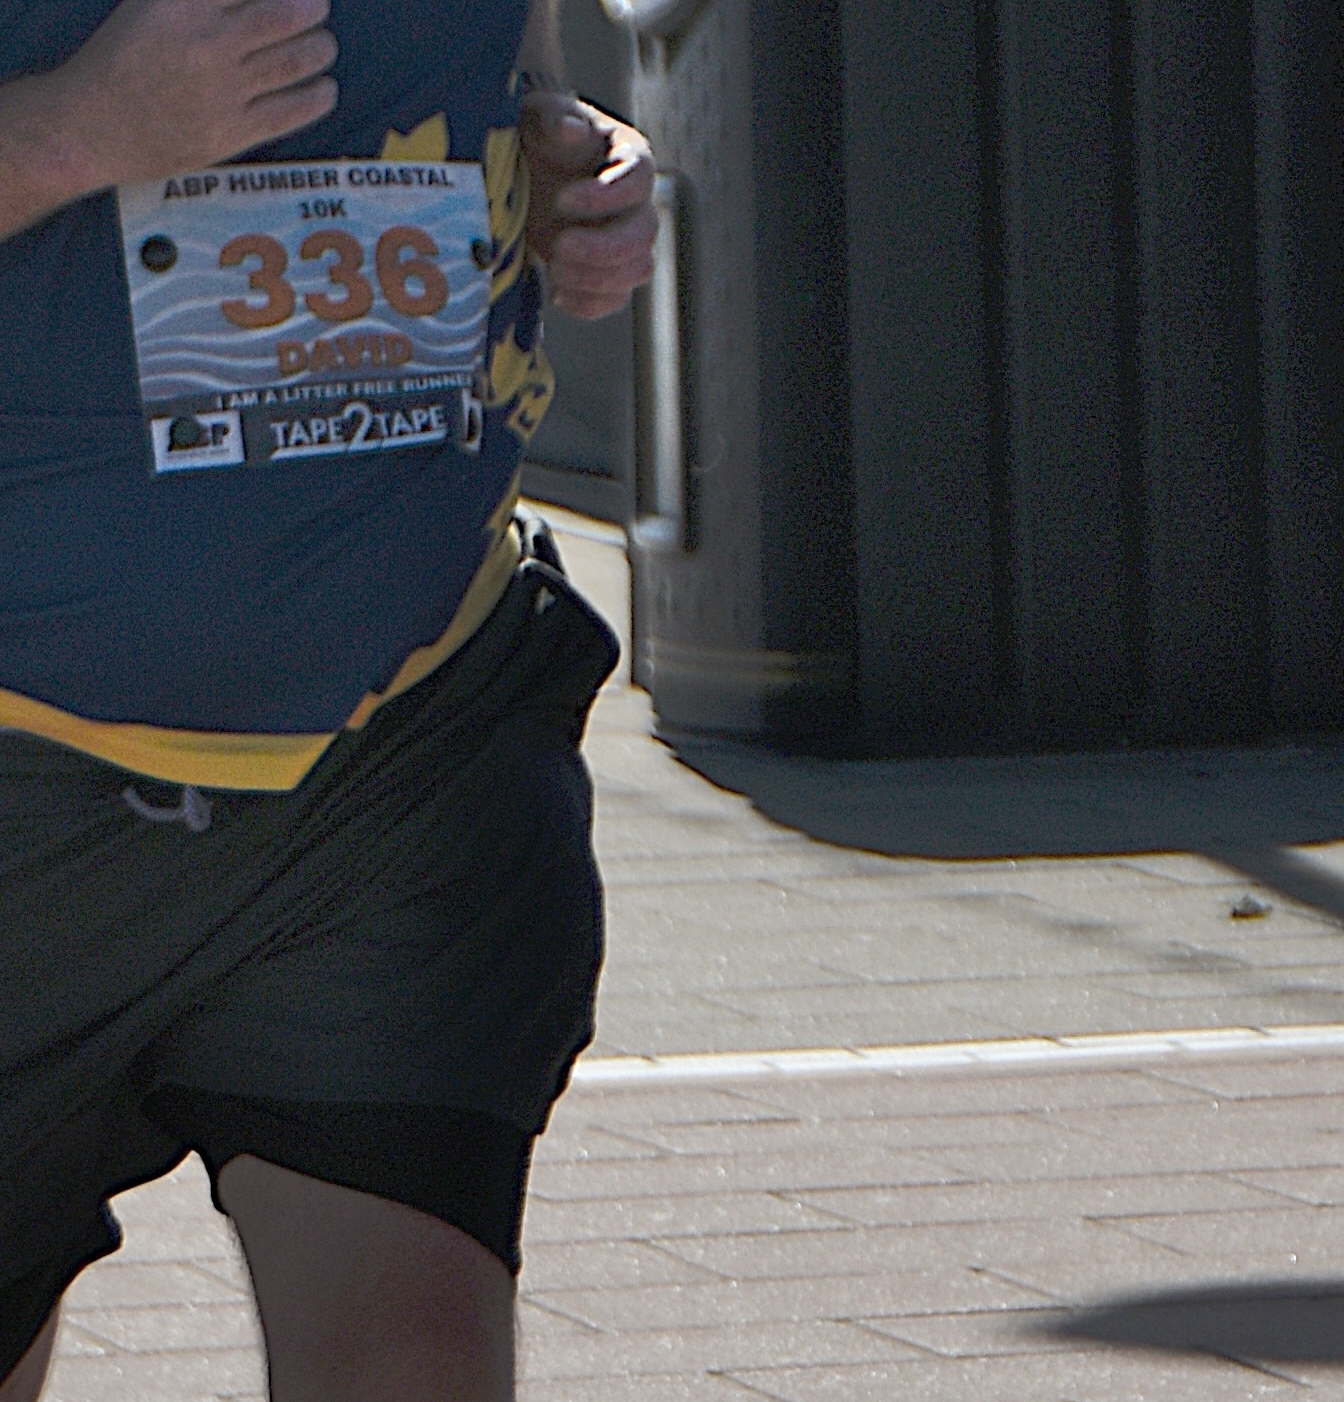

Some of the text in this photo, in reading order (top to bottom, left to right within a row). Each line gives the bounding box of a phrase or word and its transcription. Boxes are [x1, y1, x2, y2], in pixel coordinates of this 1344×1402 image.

[163, 165, 454, 200] ABP HUMBER COASTAL
[298, 197, 347, 220] 10K
[219, 225, 450, 330] 336
[276, 333, 413, 376] DAVID
[229, 390, 260, 408] AM
[265, 388, 278, 405] A
[282, 380, 348, 403] LITTER
[354, 379, 395, 397] FREE
[269, 402, 448, 459] TAPE2TAPE
